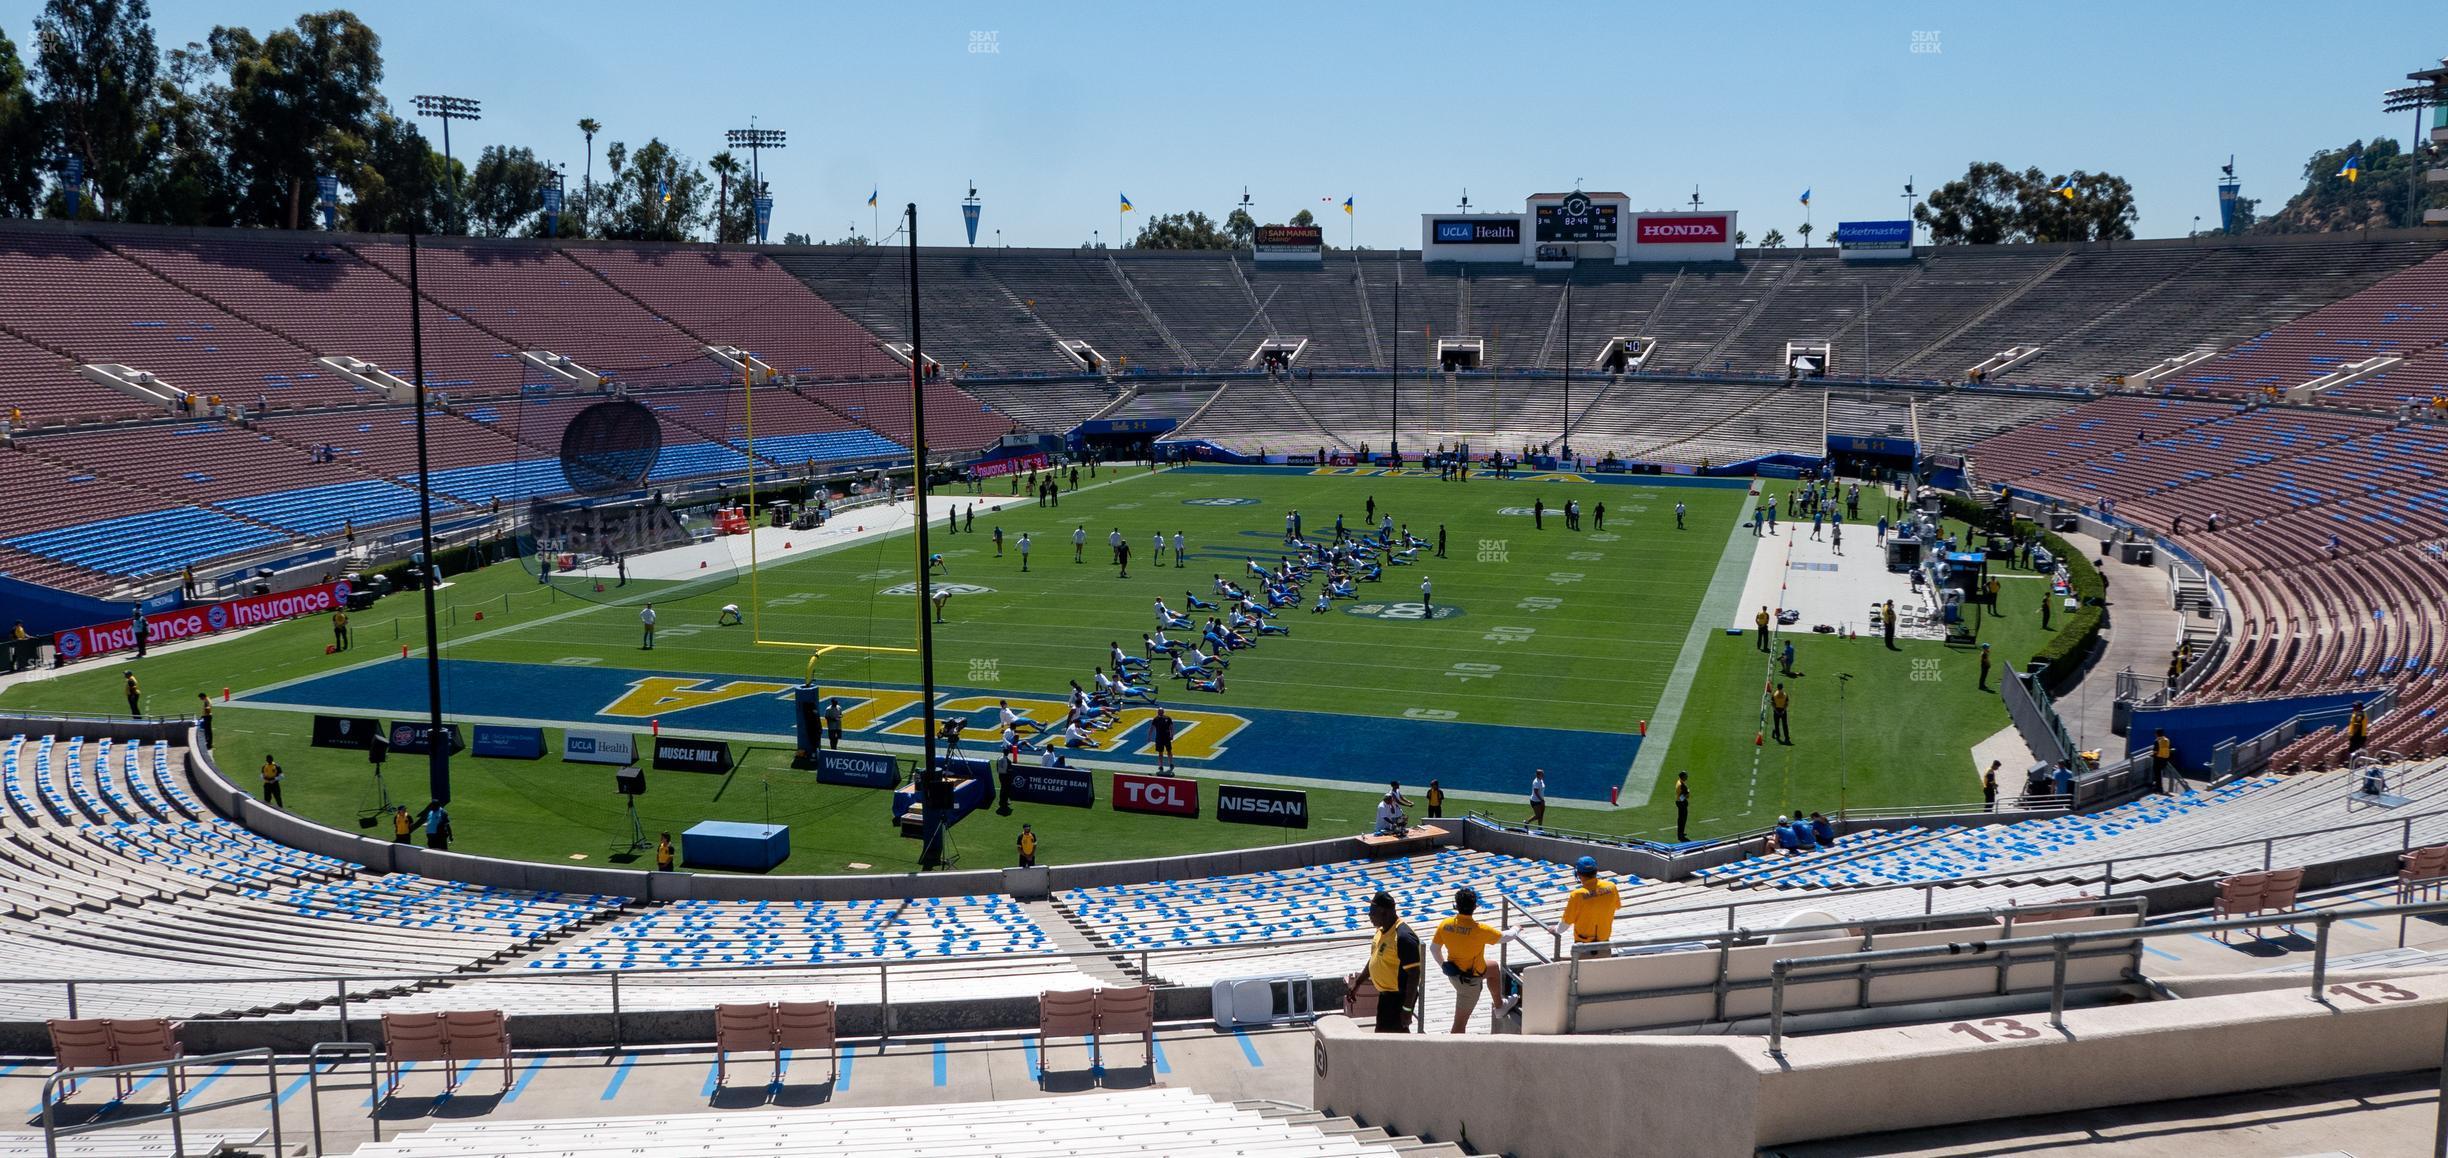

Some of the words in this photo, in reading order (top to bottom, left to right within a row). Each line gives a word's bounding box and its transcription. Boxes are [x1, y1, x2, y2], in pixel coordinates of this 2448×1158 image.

[1286, 229, 1317, 237] MANUEL
[1442, 226, 1469, 238] UCLA
[1475, 225, 1514, 238] Health
[1643, 224, 1719, 236] HONDA
[1840, 227, 1905, 237] ticketmaster
[976, 463, 1007, 477] Insurance
[233, 590, 329, 625] Insurance
[571, 740, 592, 750] UCLA
[598, 741, 629, 754] Health
[659, 747, 694, 761] MUSCLE
[696, 750, 719, 763] MILK
[825, 757, 875, 773] WESCOM
[1029, 776, 1041, 784] THE
[1042, 778, 1068, 787] COFFEE
[1124, 781, 1184, 807] TCL
[1220, 796, 1302, 816] NISSAN
[2328, 981, 2420, 1004] 13
[1948, 1018, 2041, 1043] 13
